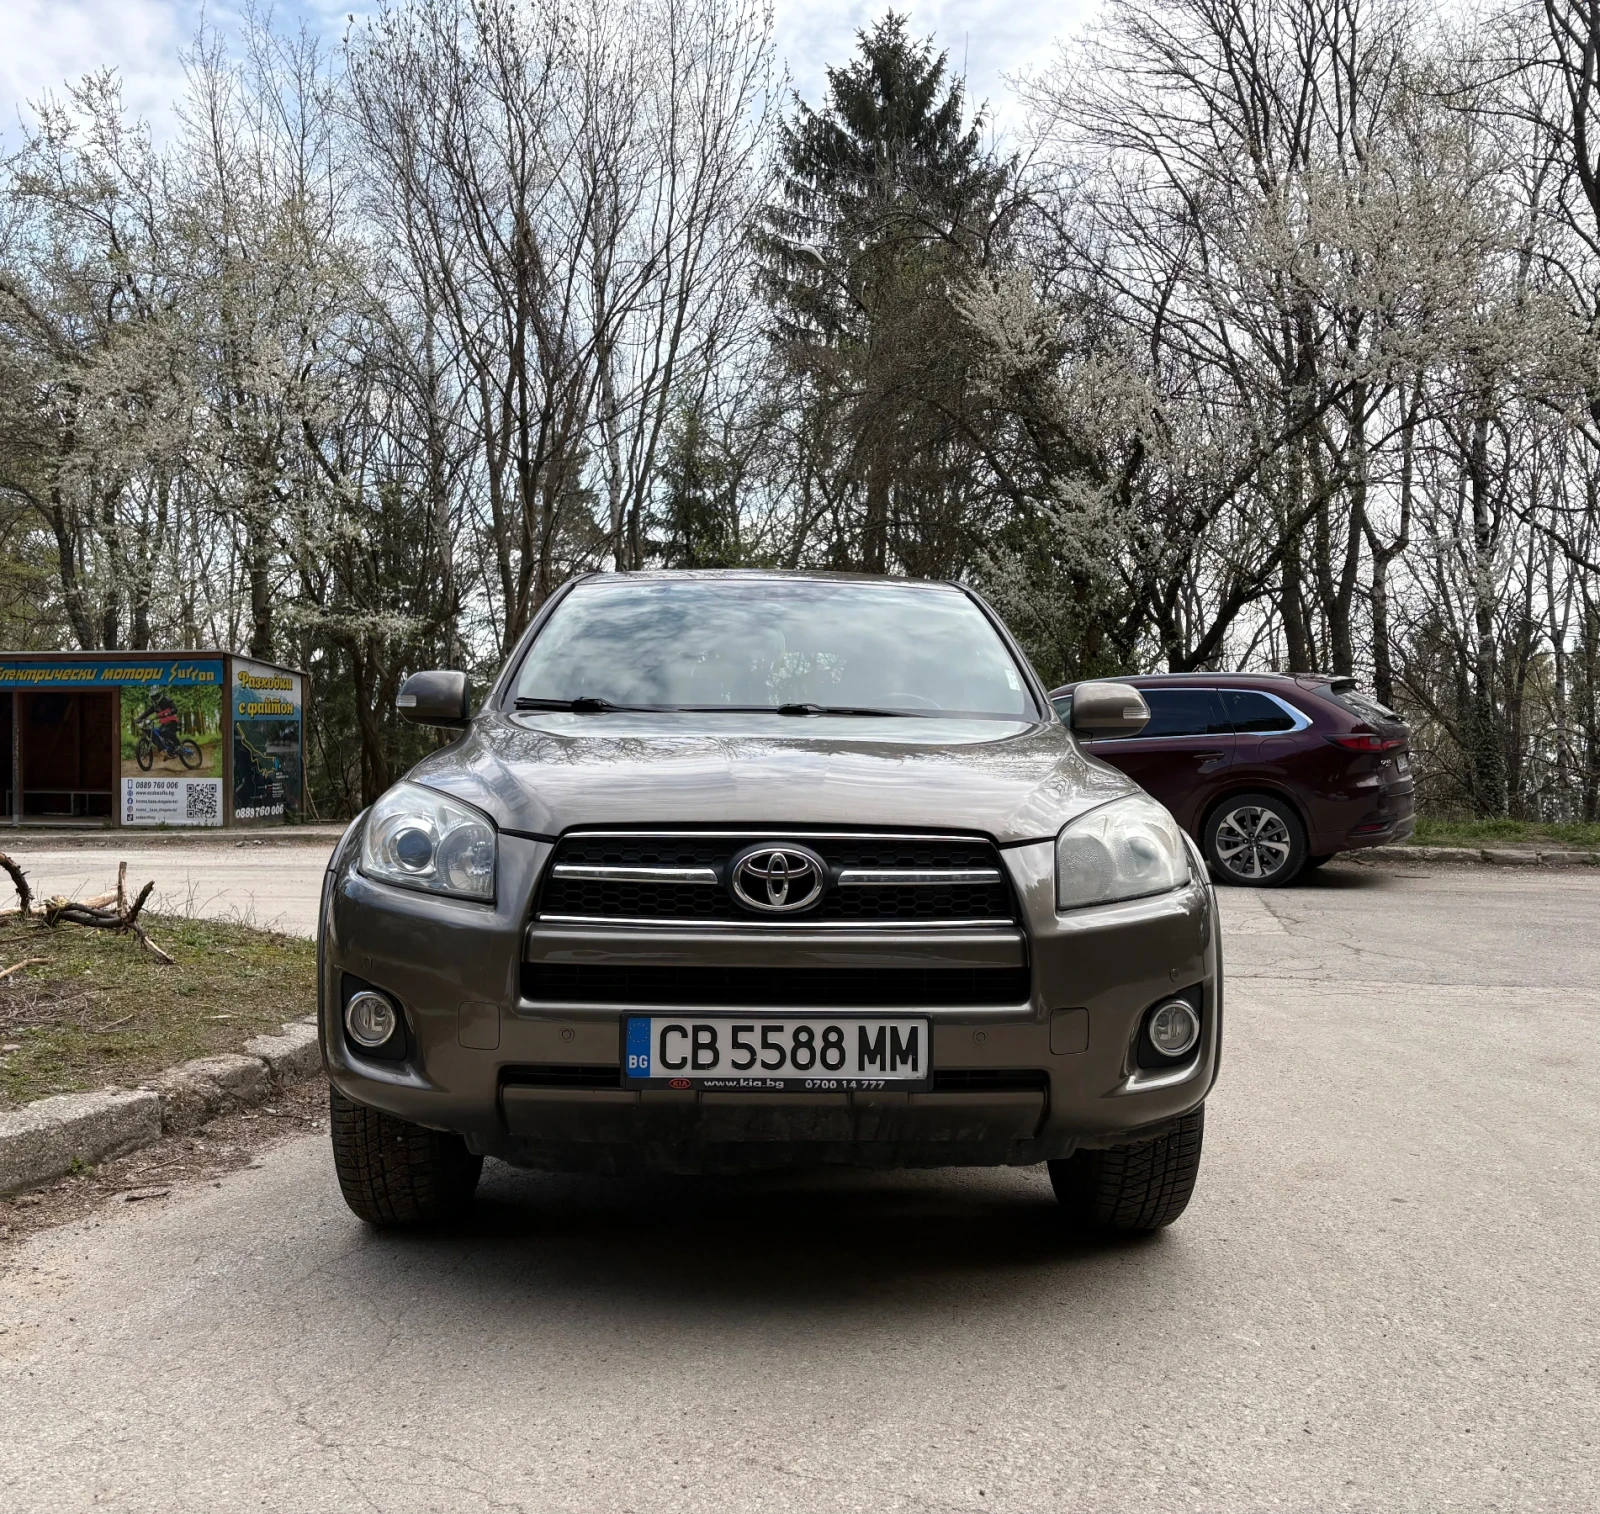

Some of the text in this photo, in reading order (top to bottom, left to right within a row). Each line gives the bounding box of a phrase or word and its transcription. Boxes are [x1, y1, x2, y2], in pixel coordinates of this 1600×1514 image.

[101, 667, 164, 682] мотори
[237, 670, 293, 691] Разходки
[238, 697, 294, 719] с файтон
[135, 781, 179, 789] 0889 760 006
[235, 803, 284, 819] 0889 760 006
[659, 1024, 919, 1072] CB 5588 MM
[628, 1054, 648, 1069] BG
[670, 1079, 690, 1088] KIA
[703, 1078, 784, 1089] www.kia.bg
[805, 1079, 886, 1090] 0700 14 777
